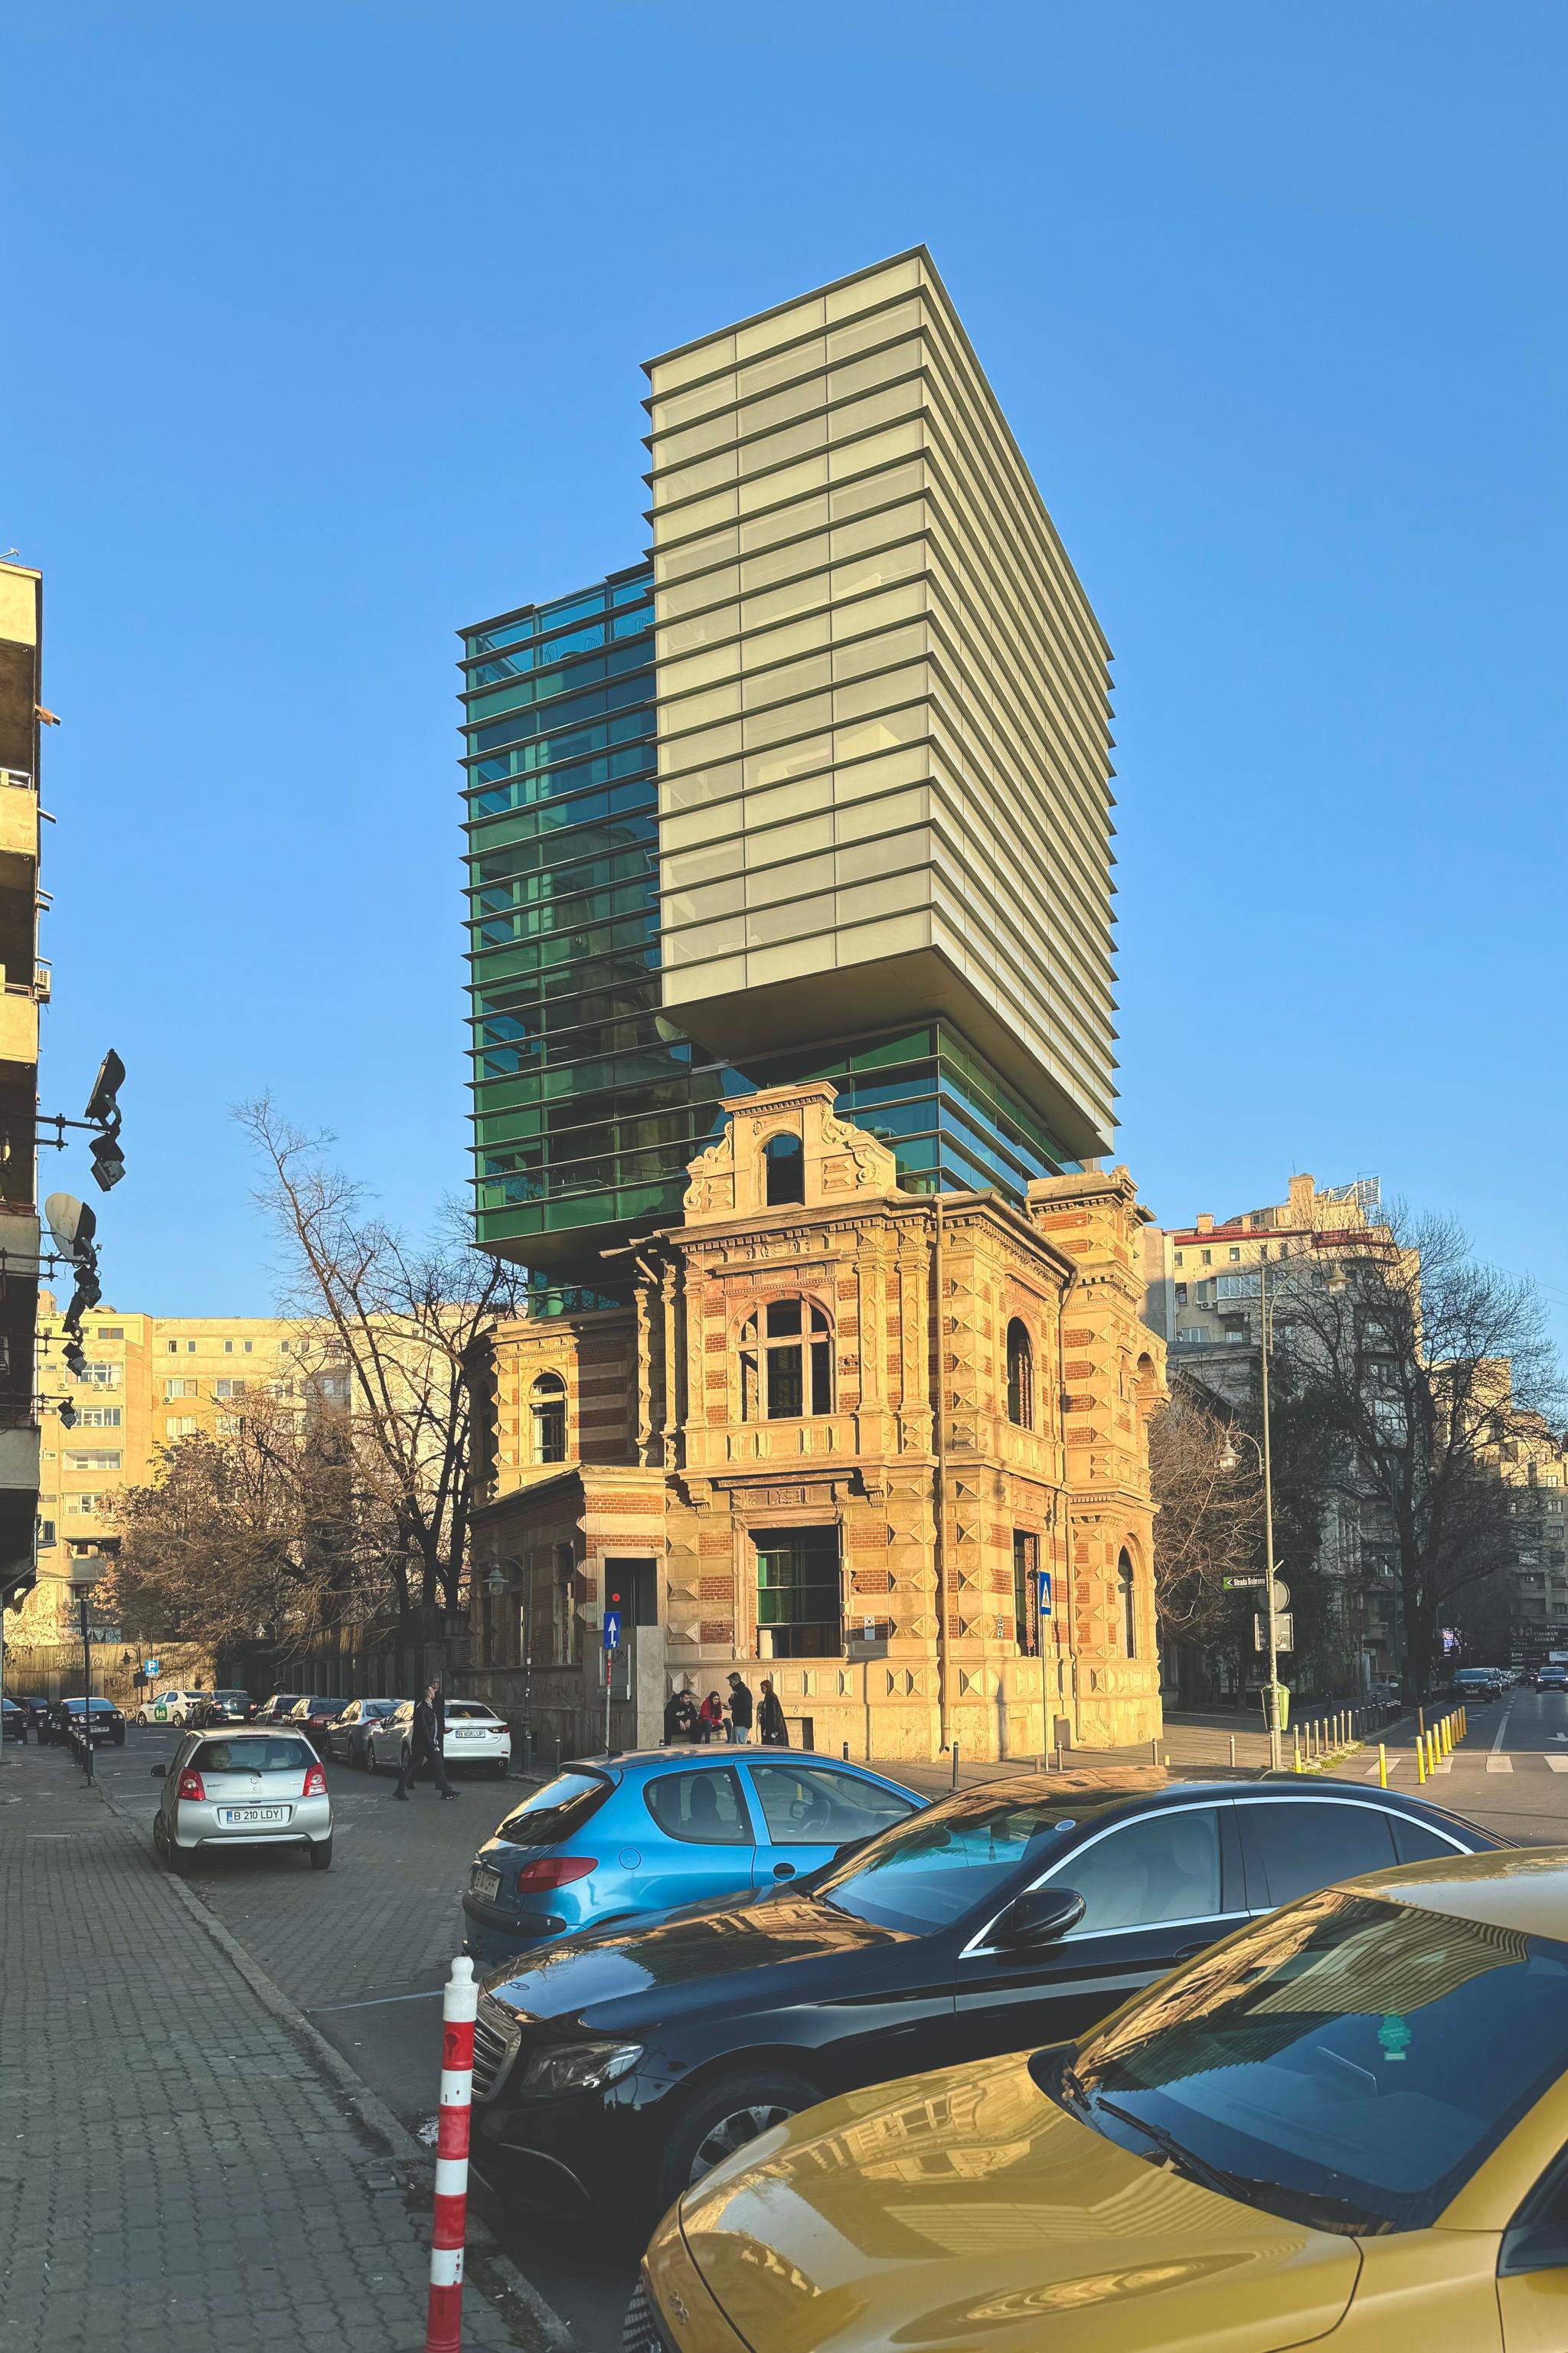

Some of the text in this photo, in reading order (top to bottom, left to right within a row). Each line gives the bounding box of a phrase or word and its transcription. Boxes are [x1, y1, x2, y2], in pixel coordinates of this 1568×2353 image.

[234, 1810, 279, 1820] B 210 LDY
